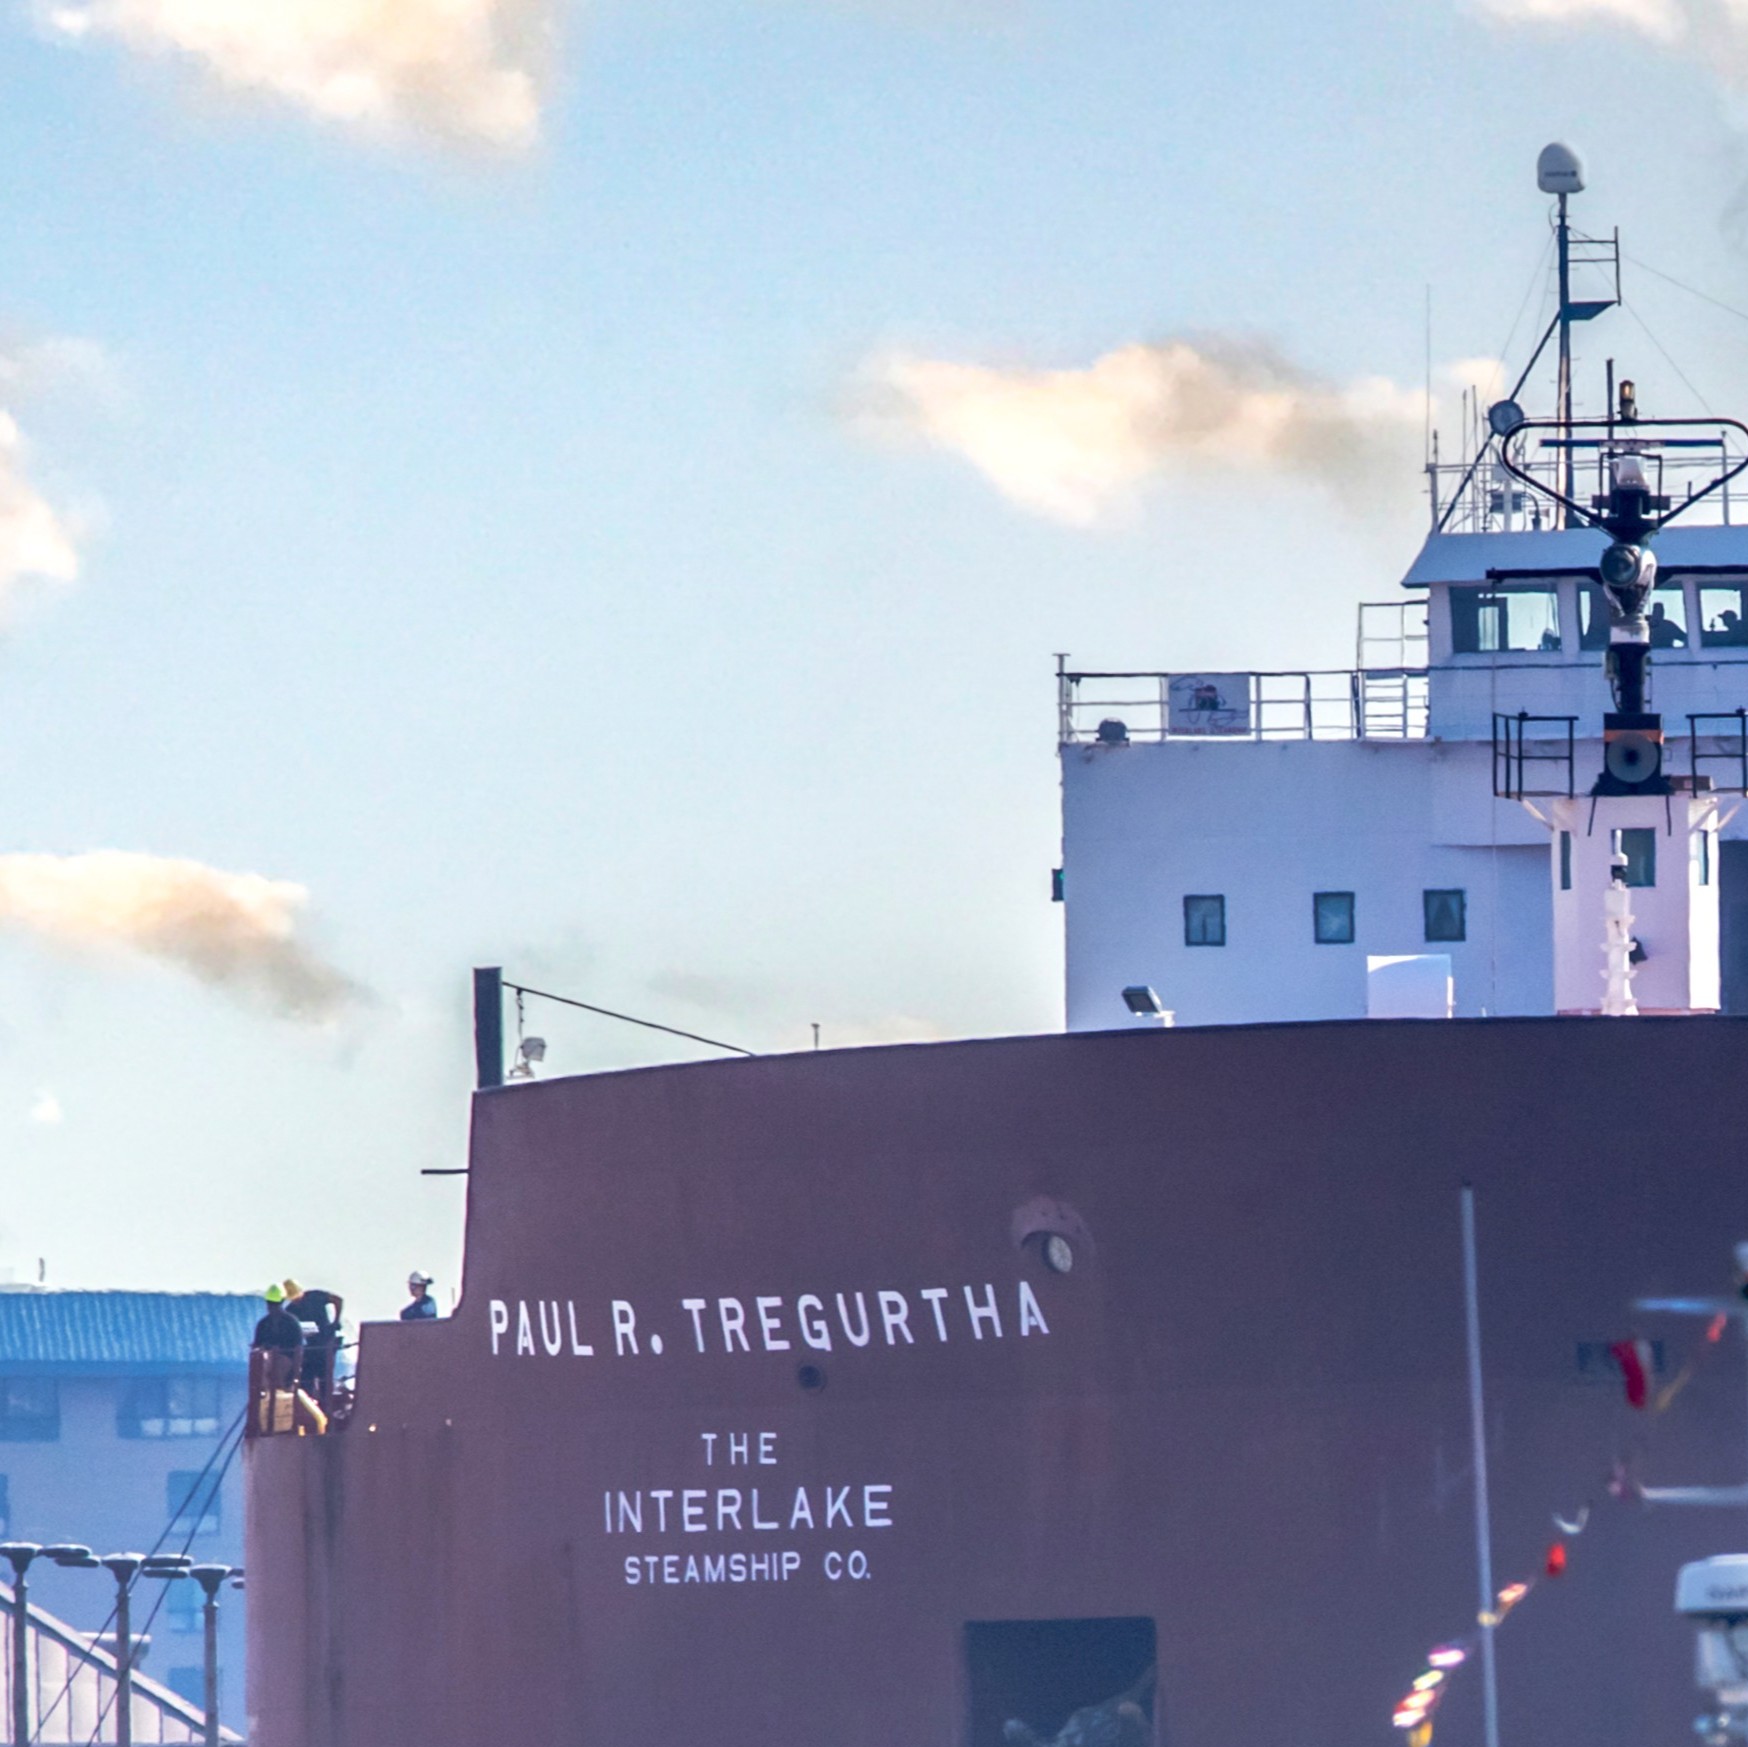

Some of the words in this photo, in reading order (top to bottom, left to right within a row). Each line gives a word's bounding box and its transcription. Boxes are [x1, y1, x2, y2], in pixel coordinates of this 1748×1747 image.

[488, 1298, 595, 1357] PAUL
[610, 1299, 664, 1357] R.
[680, 1279, 1051, 1354] TREGURTHA
[700, 1431, 778, 1467] THE
[604, 1483, 895, 1534] INTERLAKE
[623, 1550, 802, 1586] STEAMSHIP
[822, 1549, 873, 1582] CO.
